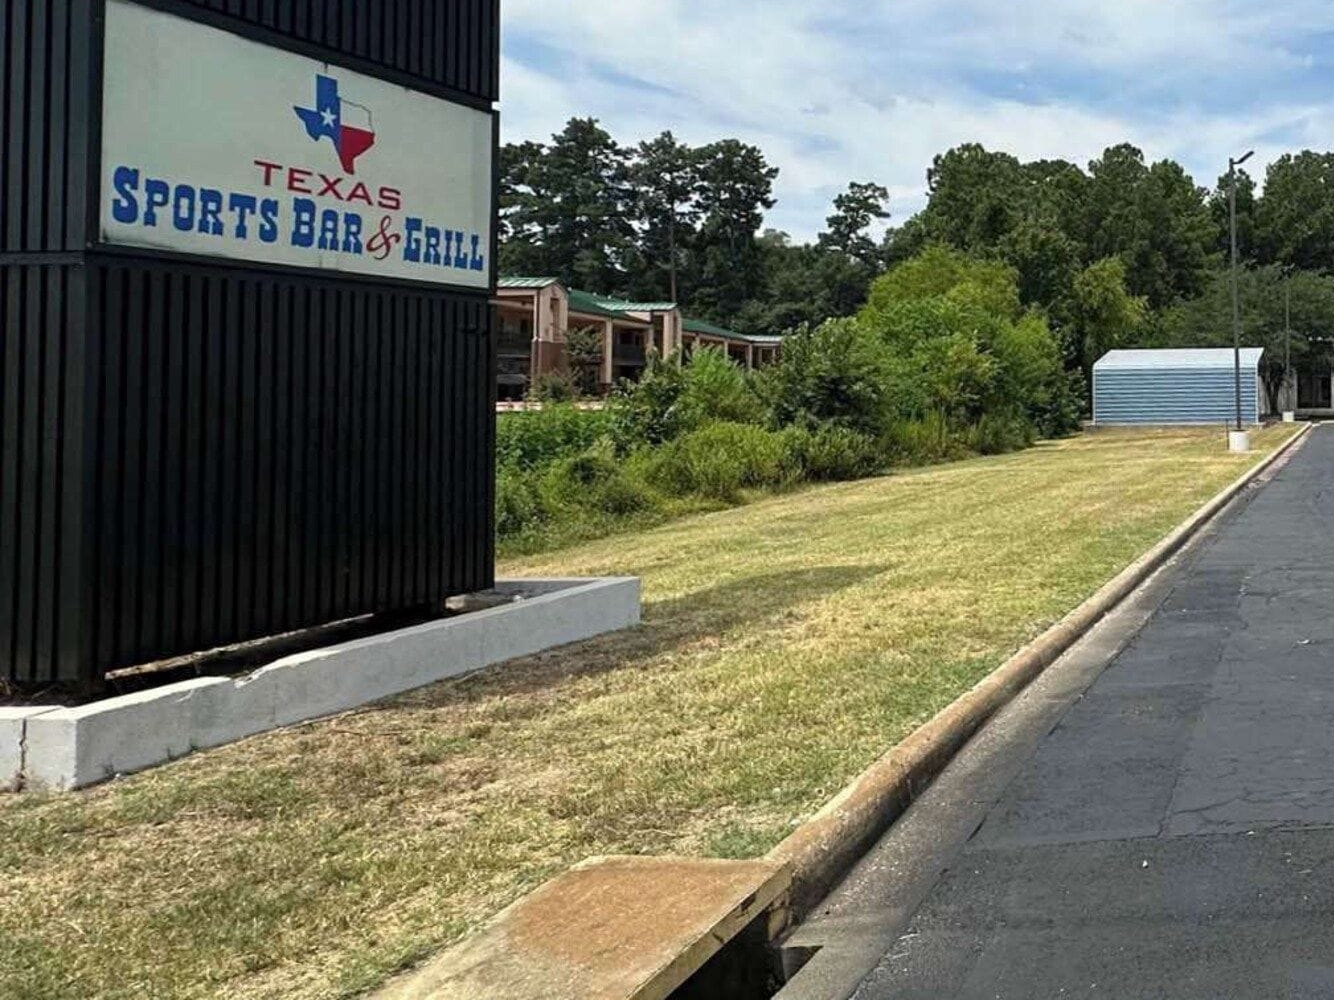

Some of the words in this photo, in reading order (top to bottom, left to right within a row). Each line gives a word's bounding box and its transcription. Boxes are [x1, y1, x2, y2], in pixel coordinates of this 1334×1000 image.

[112, 165, 279, 243] SPORTS
[291, 198, 363, 254] BAR
[366, 215, 401, 260] &
[403, 217, 484, 272] GRILL
[254, 160, 401, 210] TEXAS
